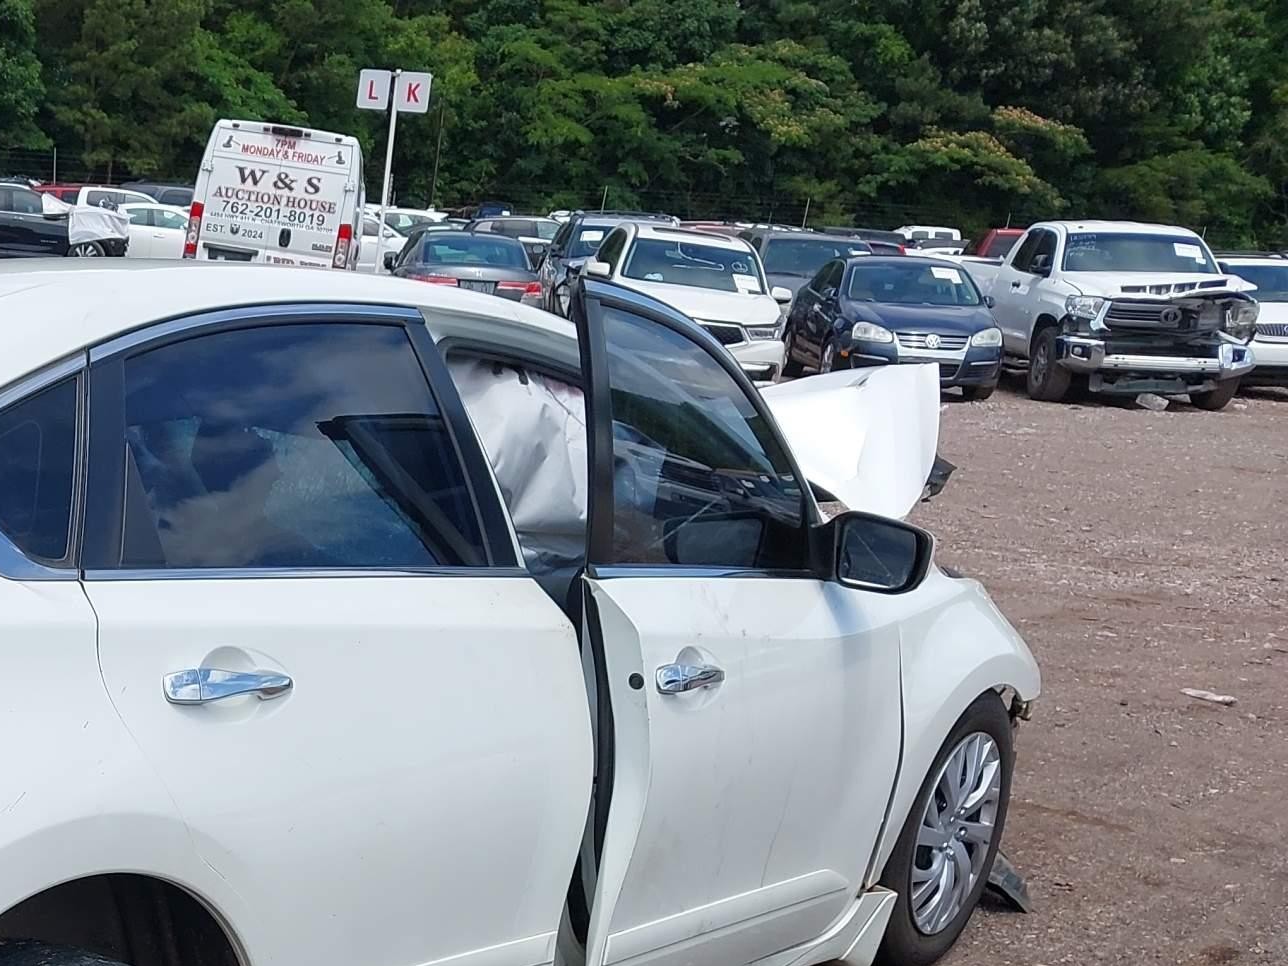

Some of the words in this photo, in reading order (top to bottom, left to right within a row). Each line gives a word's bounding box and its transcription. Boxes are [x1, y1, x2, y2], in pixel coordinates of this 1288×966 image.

[368, 80, 378, 100] L
[407, 82, 420, 103] K
[241, 144, 282, 158] MONDAY
[282, 150, 289, 159] &
[292, 152, 326, 165] FRIDAY
[276, 138, 296, 150] 7PM
[236, 166, 269, 186] W
[273, 172, 297, 192] &
[304, 176, 322, 195] S
[214, 186, 286, 206] AUCTION
[286, 198, 337, 214] HOUSE
[222, 200, 325, 226] 762-201-8019
[206, 223, 226, 234] EST.
[241, 229, 263, 239] 2024
